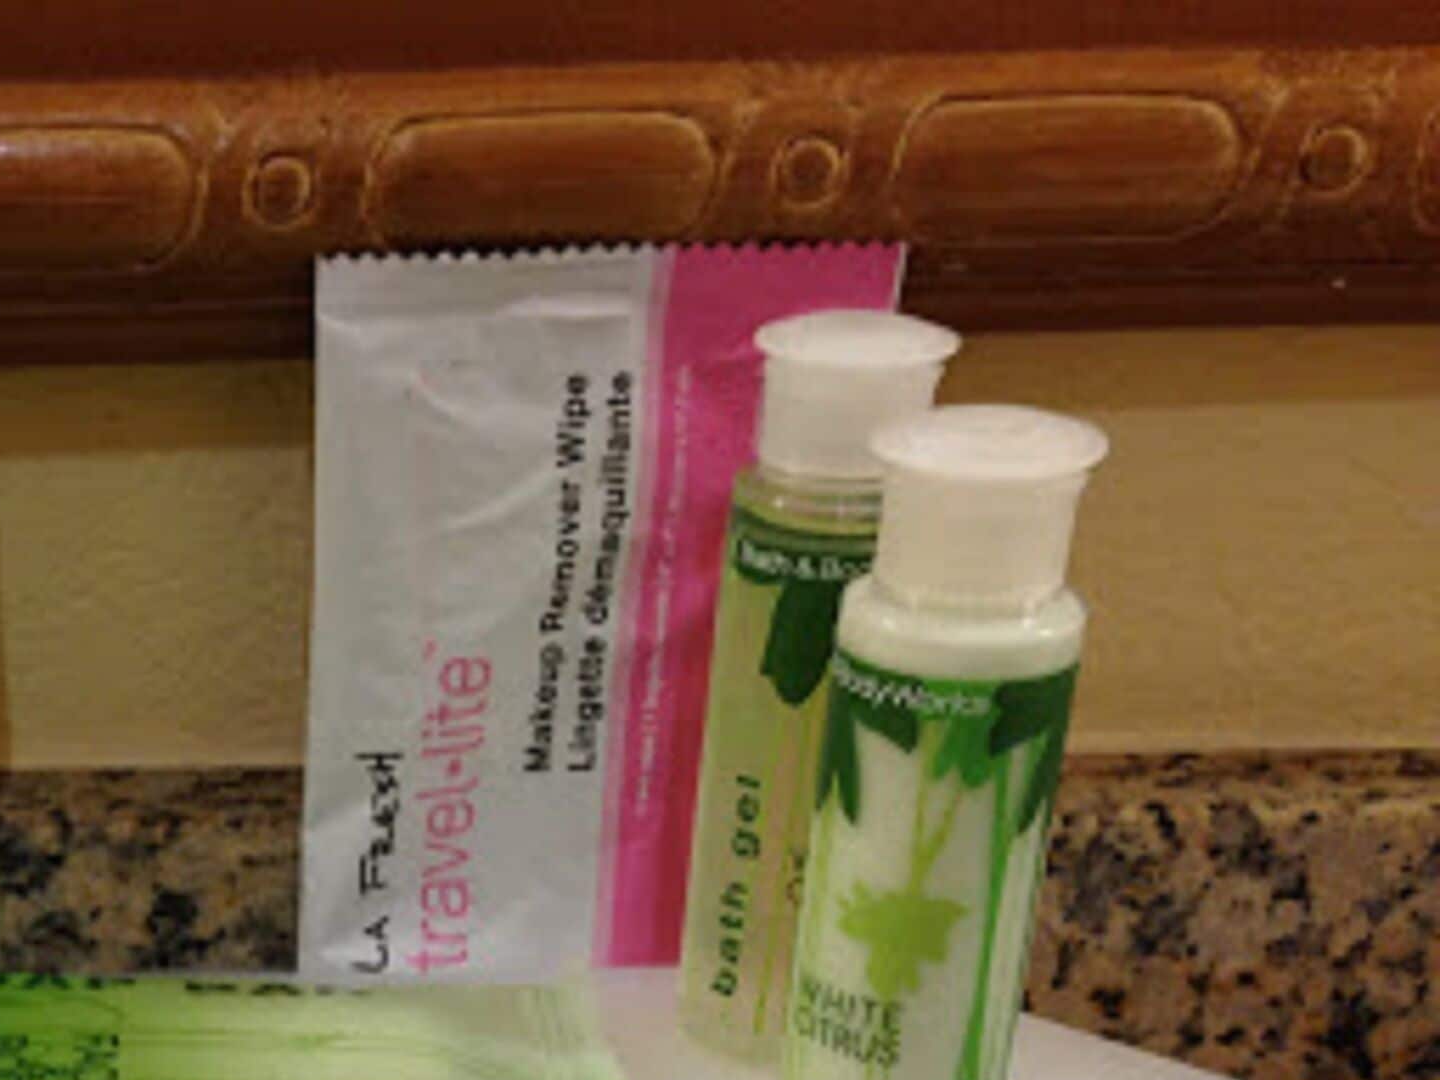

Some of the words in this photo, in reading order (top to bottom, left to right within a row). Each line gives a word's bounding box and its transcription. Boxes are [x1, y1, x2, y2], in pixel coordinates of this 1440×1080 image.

[555, 374, 592, 470] Wipe
[538, 476, 582, 635] Remover
[522, 641, 565, 773] Makeup
[566, 635, 608, 772] Lingette
[354, 751, 405, 897] FRESH
[729, 774, 762, 859] gel
[351, 913, 392, 975] LA
[710, 881, 749, 998] bath
[794, 1004, 902, 1070] CITRUS
[800, 976, 906, 1034] WHITE
